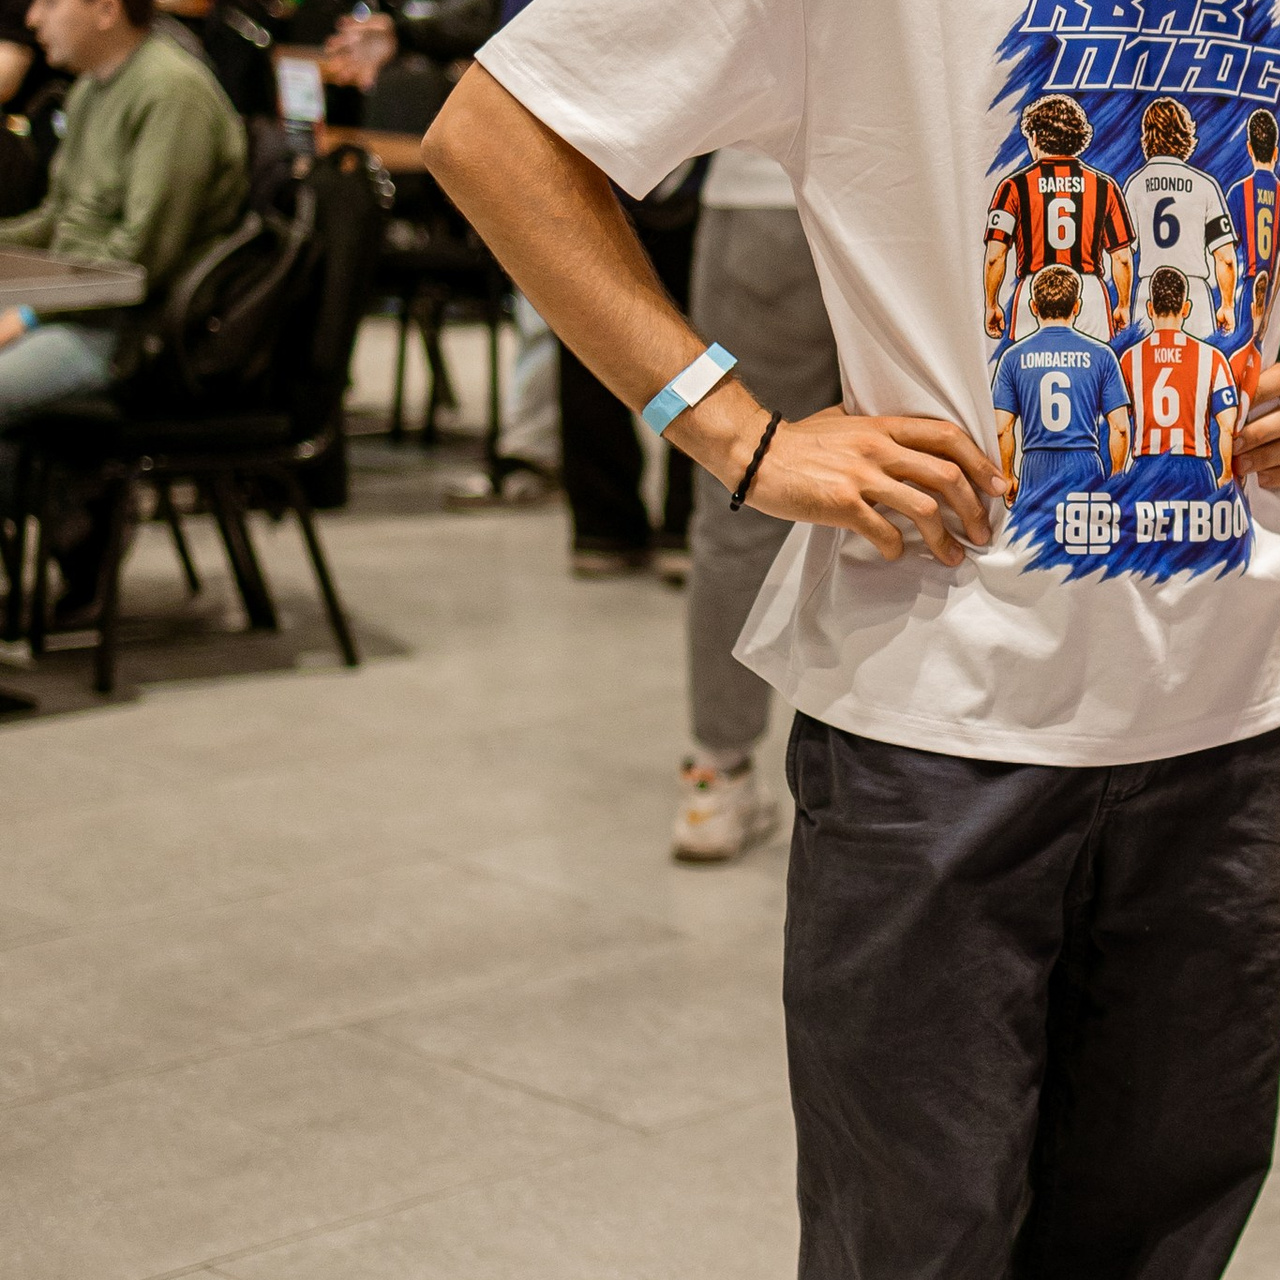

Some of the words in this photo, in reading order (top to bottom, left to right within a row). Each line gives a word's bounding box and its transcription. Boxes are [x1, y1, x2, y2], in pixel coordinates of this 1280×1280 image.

[1037, 176, 1085, 194] BARESI
[1145, 176, 1193, 193] REDONDO
[1257, 188, 1275, 206] XAVI
[991, 213, 1000, 226] C
[1047, 197, 1076, 250] 6
[1152, 196, 1181, 249] 6
[1220, 217, 1231, 233] C
[1257, 207, 1273, 260] 6
[1020, 351, 1091, 370] LOMBAERTS
[1154, 348, 1183, 364] KOKE
[1040, 371, 1072, 432] 6
[1152, 367, 1180, 428] 6
[1221, 389, 1234, 406] C
[1135, 500, 1249, 544] BETBOO
